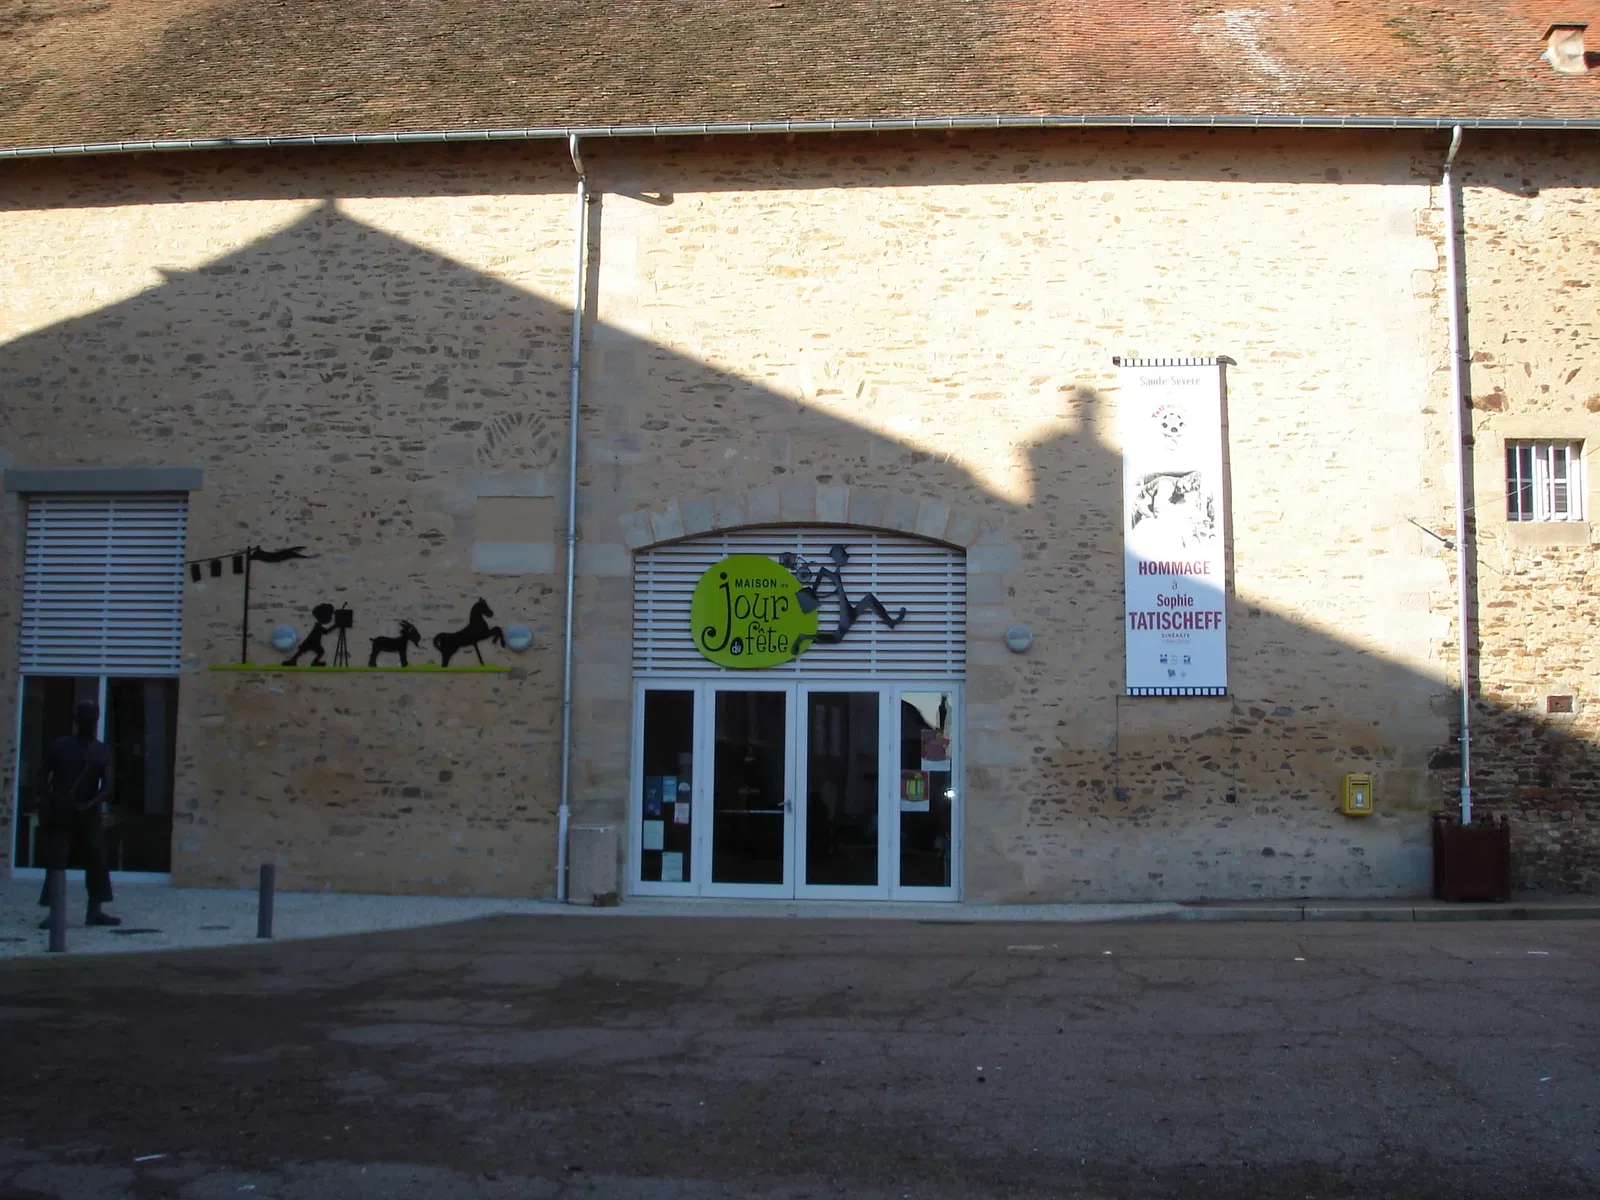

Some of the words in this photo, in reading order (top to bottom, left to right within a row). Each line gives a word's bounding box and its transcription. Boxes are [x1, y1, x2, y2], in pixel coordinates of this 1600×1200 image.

[1138, 560, 1211, 576] HOMMAGE
[734, 578, 777, 588] MAISON
[1172, 579, 1178, 590] à
[1156, 593, 1194, 609] Sophie
[1128, 611, 1222, 630] TATISCHEFF
[745, 621, 789, 655] fête
